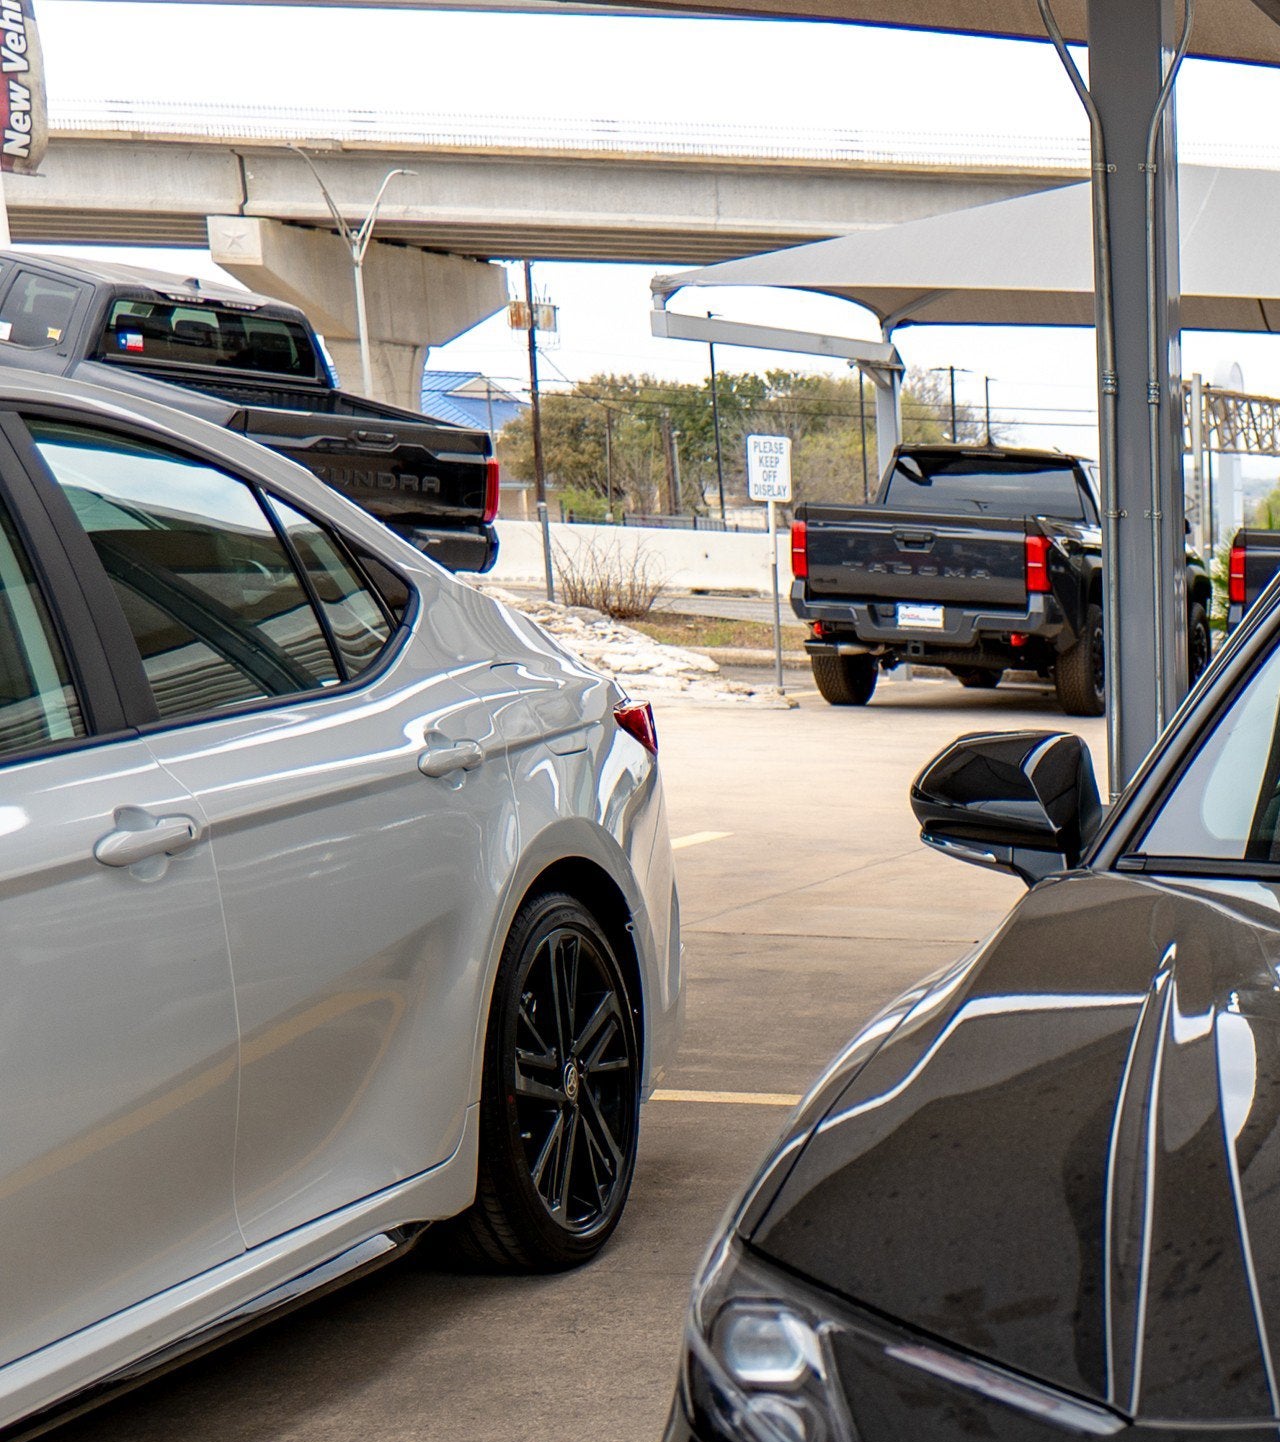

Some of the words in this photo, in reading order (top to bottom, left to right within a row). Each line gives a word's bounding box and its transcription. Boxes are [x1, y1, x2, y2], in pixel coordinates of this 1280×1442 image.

[3, 80, 32, 158] New
[753, 441, 785, 455] PLEASE
[759, 456, 780, 468] KEEP
[762, 470, 778, 482] OFF
[753, 483, 788, 497] DISPLAY
[841, 561, 991, 580] TACOMA
